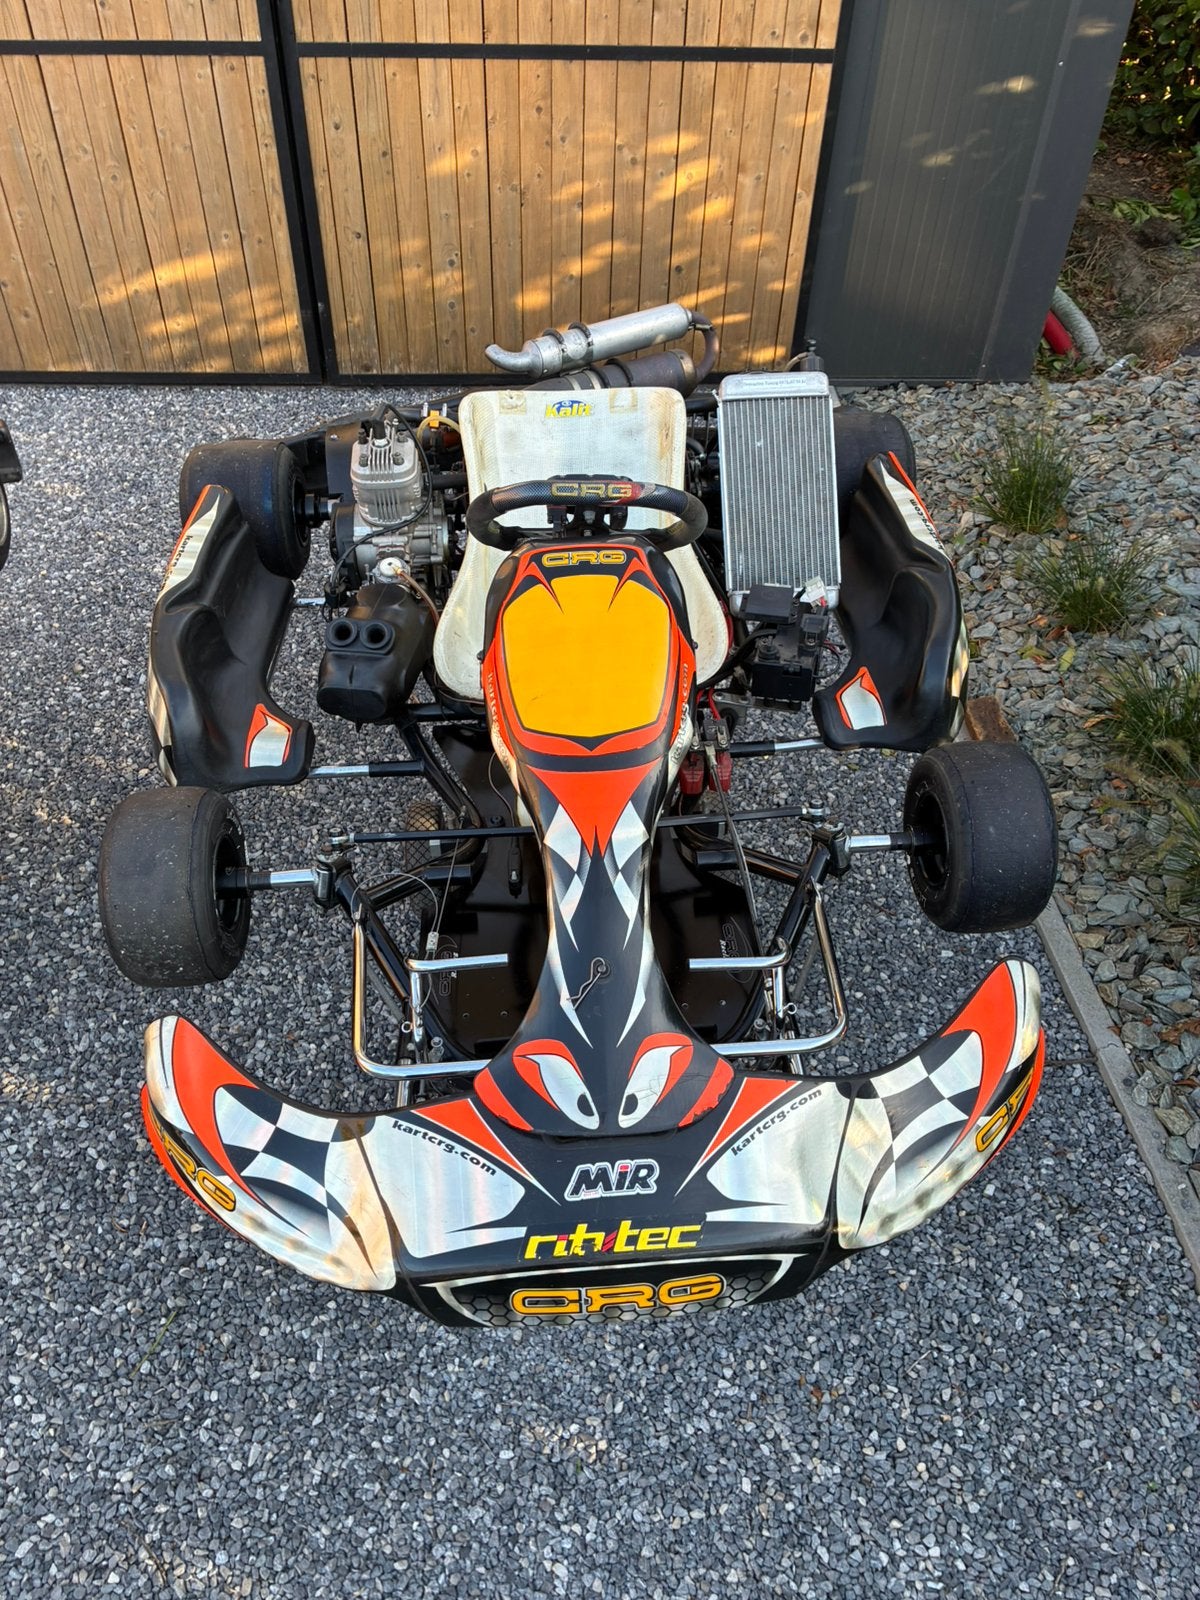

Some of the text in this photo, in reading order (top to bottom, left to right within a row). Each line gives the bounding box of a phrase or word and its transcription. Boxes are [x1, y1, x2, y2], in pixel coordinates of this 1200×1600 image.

[551, 482, 632, 498] CRG
[541, 549, 627, 567] CRG
[730, 1088, 822, 1157] kartcrg.com
[391, 1119, 497, 1177] kartcrg.com
[510, 1272, 726, 1316] CRG
